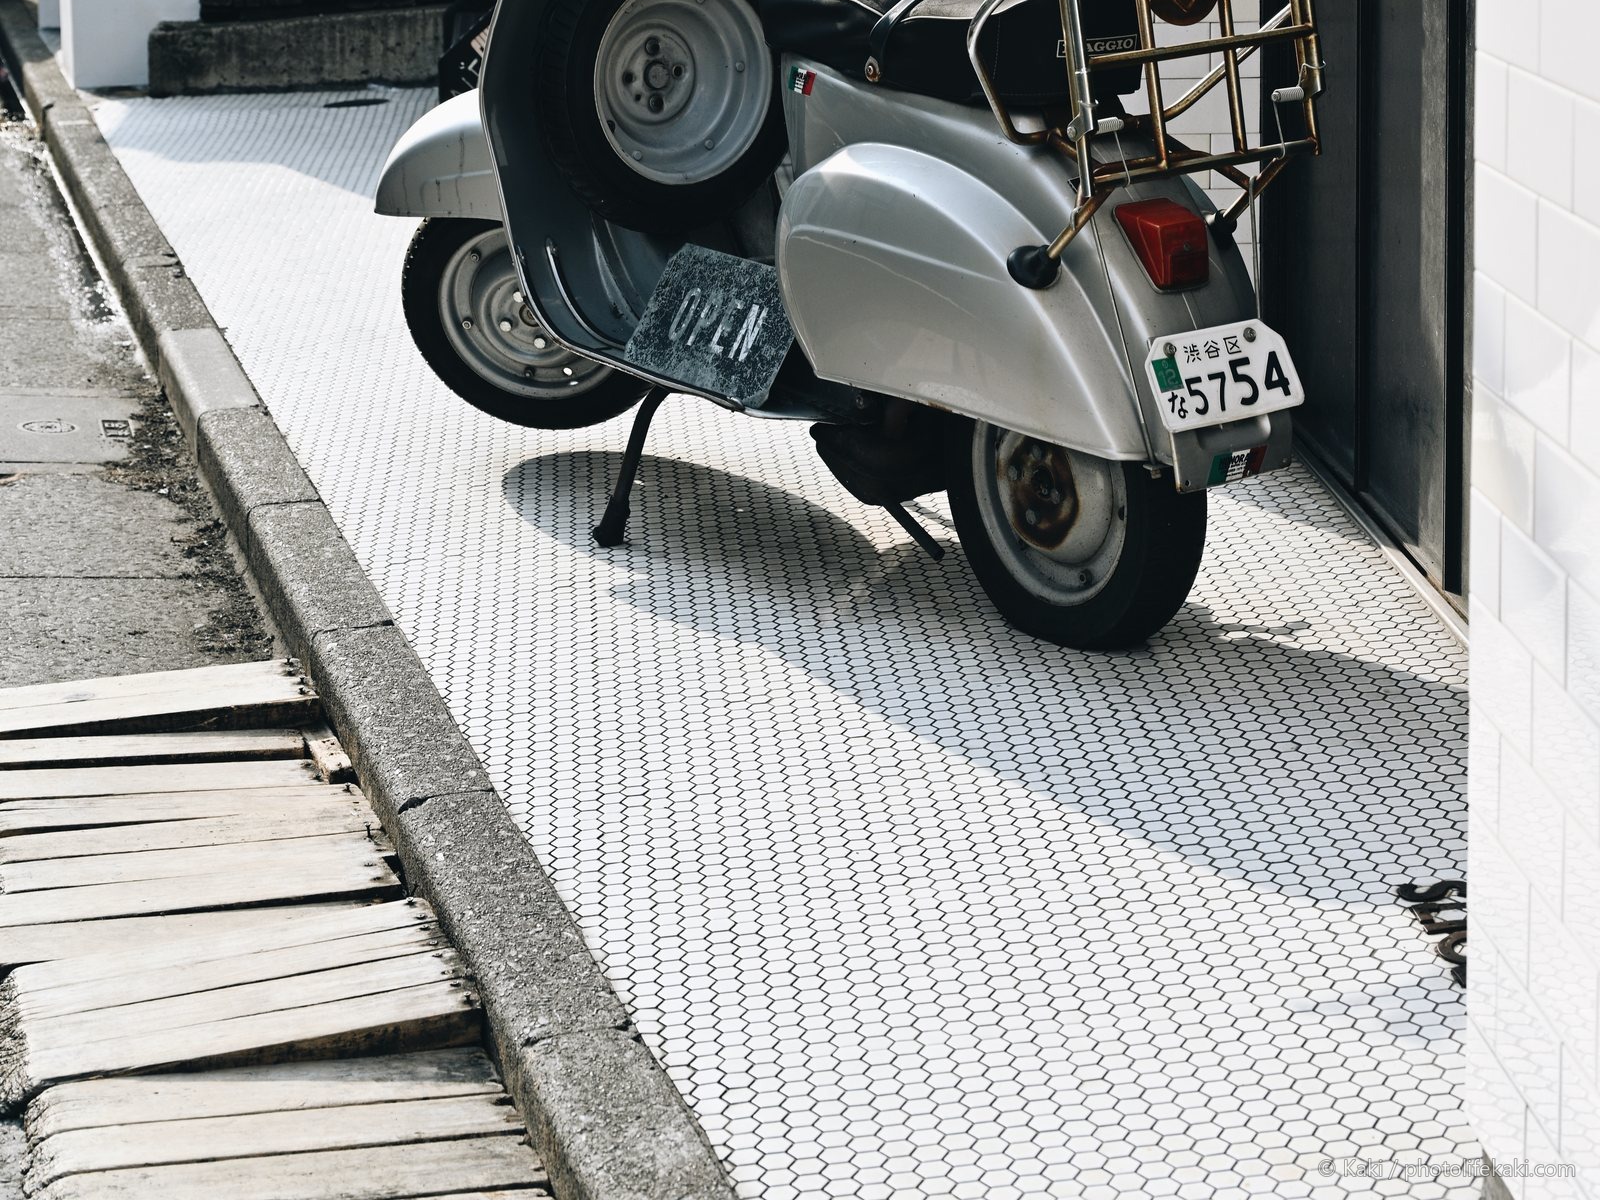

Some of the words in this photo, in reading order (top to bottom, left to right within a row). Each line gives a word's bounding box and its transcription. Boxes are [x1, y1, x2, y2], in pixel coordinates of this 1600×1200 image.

[1061, 38, 1134, 54] AGGIO
[1183, 335, 1242, 364] 渋谷区
[1167, 391, 1189, 419] な
[1185, 350, 1292, 416] 5754
